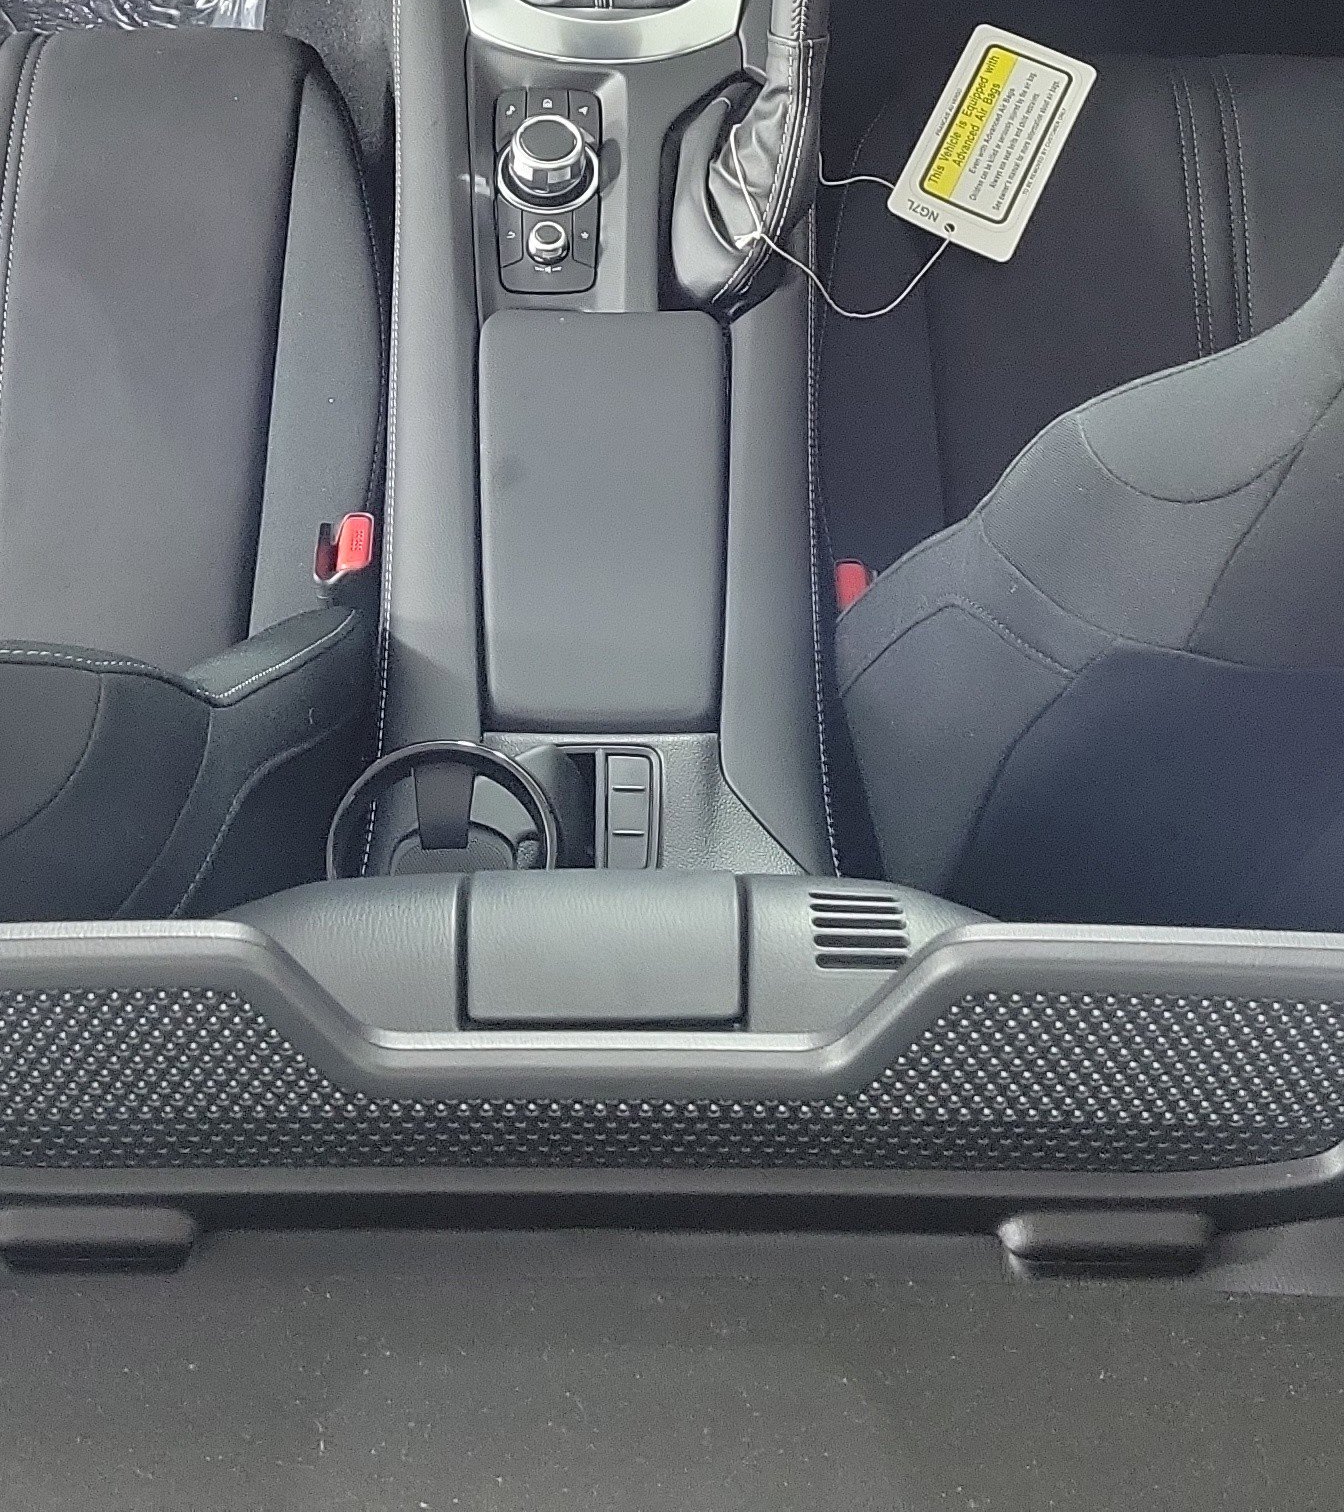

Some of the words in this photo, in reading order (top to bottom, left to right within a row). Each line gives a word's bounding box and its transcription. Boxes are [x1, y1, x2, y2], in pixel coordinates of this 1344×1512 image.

[927, 164, 945, 183] This
[938, 131, 961, 161] Vehicle
[955, 119, 967, 129] is
[961, 75, 988, 117] Equipped
[984, 55, 999, 73] with
[952, 123, 980, 167] Advanced
[974, 107, 987, 122] Air
[981, 83, 1001, 107] Bags
[983, 112, 1002, 144] Advanced
[907, 198, 940, 223] NG7L
